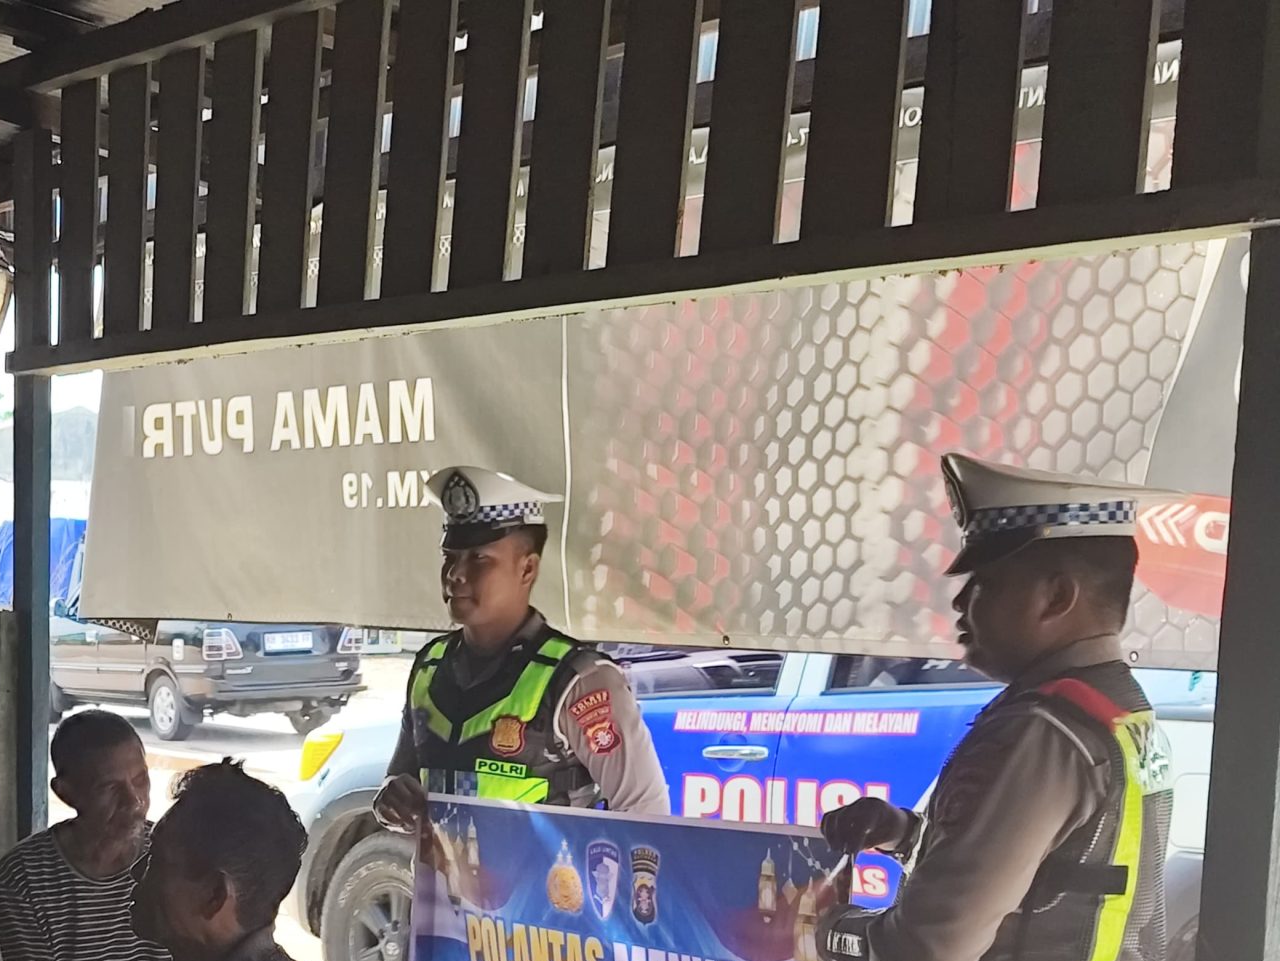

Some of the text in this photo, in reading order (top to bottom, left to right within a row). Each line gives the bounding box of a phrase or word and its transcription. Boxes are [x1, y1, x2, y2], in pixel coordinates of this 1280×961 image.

[750, 711, 822, 734] MENGAYOMI
[823, 712, 851, 734] DAN
[852, 711, 920, 735] MELAYANI
[478, 760, 524, 776] POLRI
